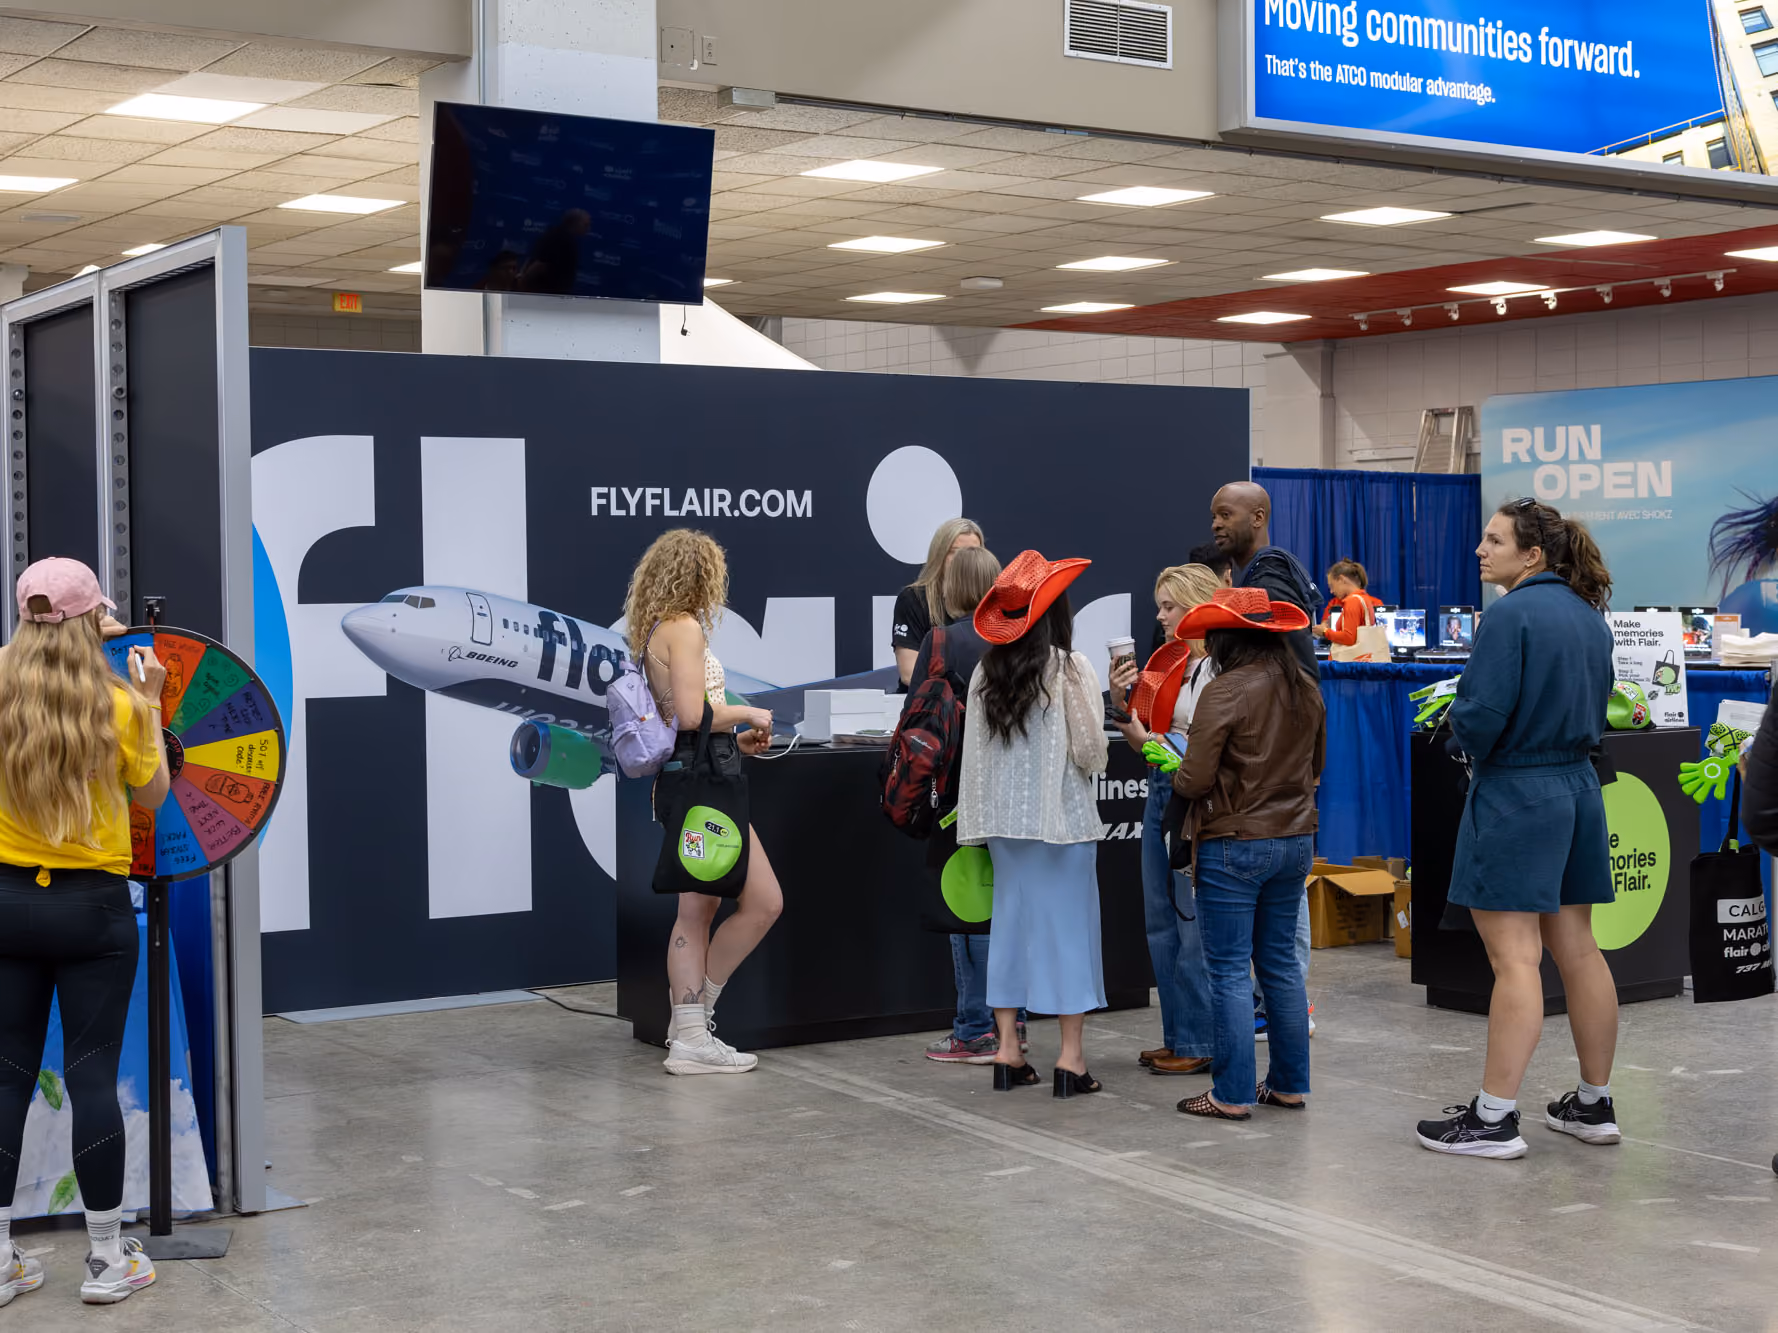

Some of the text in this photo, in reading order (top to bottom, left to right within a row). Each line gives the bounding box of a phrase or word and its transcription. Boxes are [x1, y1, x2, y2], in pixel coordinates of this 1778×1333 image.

[1265, 0, 1640, 78] Moving communities forward.
[1265, 54, 1496, 106] That's the ATCO modular advantage.
[340, 294, 358, 309] EXIT
[1502, 424, 1602, 464] RUN
[1533, 461, 1672, 500] OPEN
[591, 487, 812, 517] FLYFLAIR.COM
[1613, 619, 1641, 628] Make
[1614, 629, 1664, 638] memories
[1615, 637, 1661, 647] with Flair.
[465, 650, 519, 668] BOEING
[707, 822, 720, 834] 21.1
[1614, 869, 1651, 893] Flair.
[1724, 946, 1749, 957] flair
[1736, 962, 1761, 974] 737
